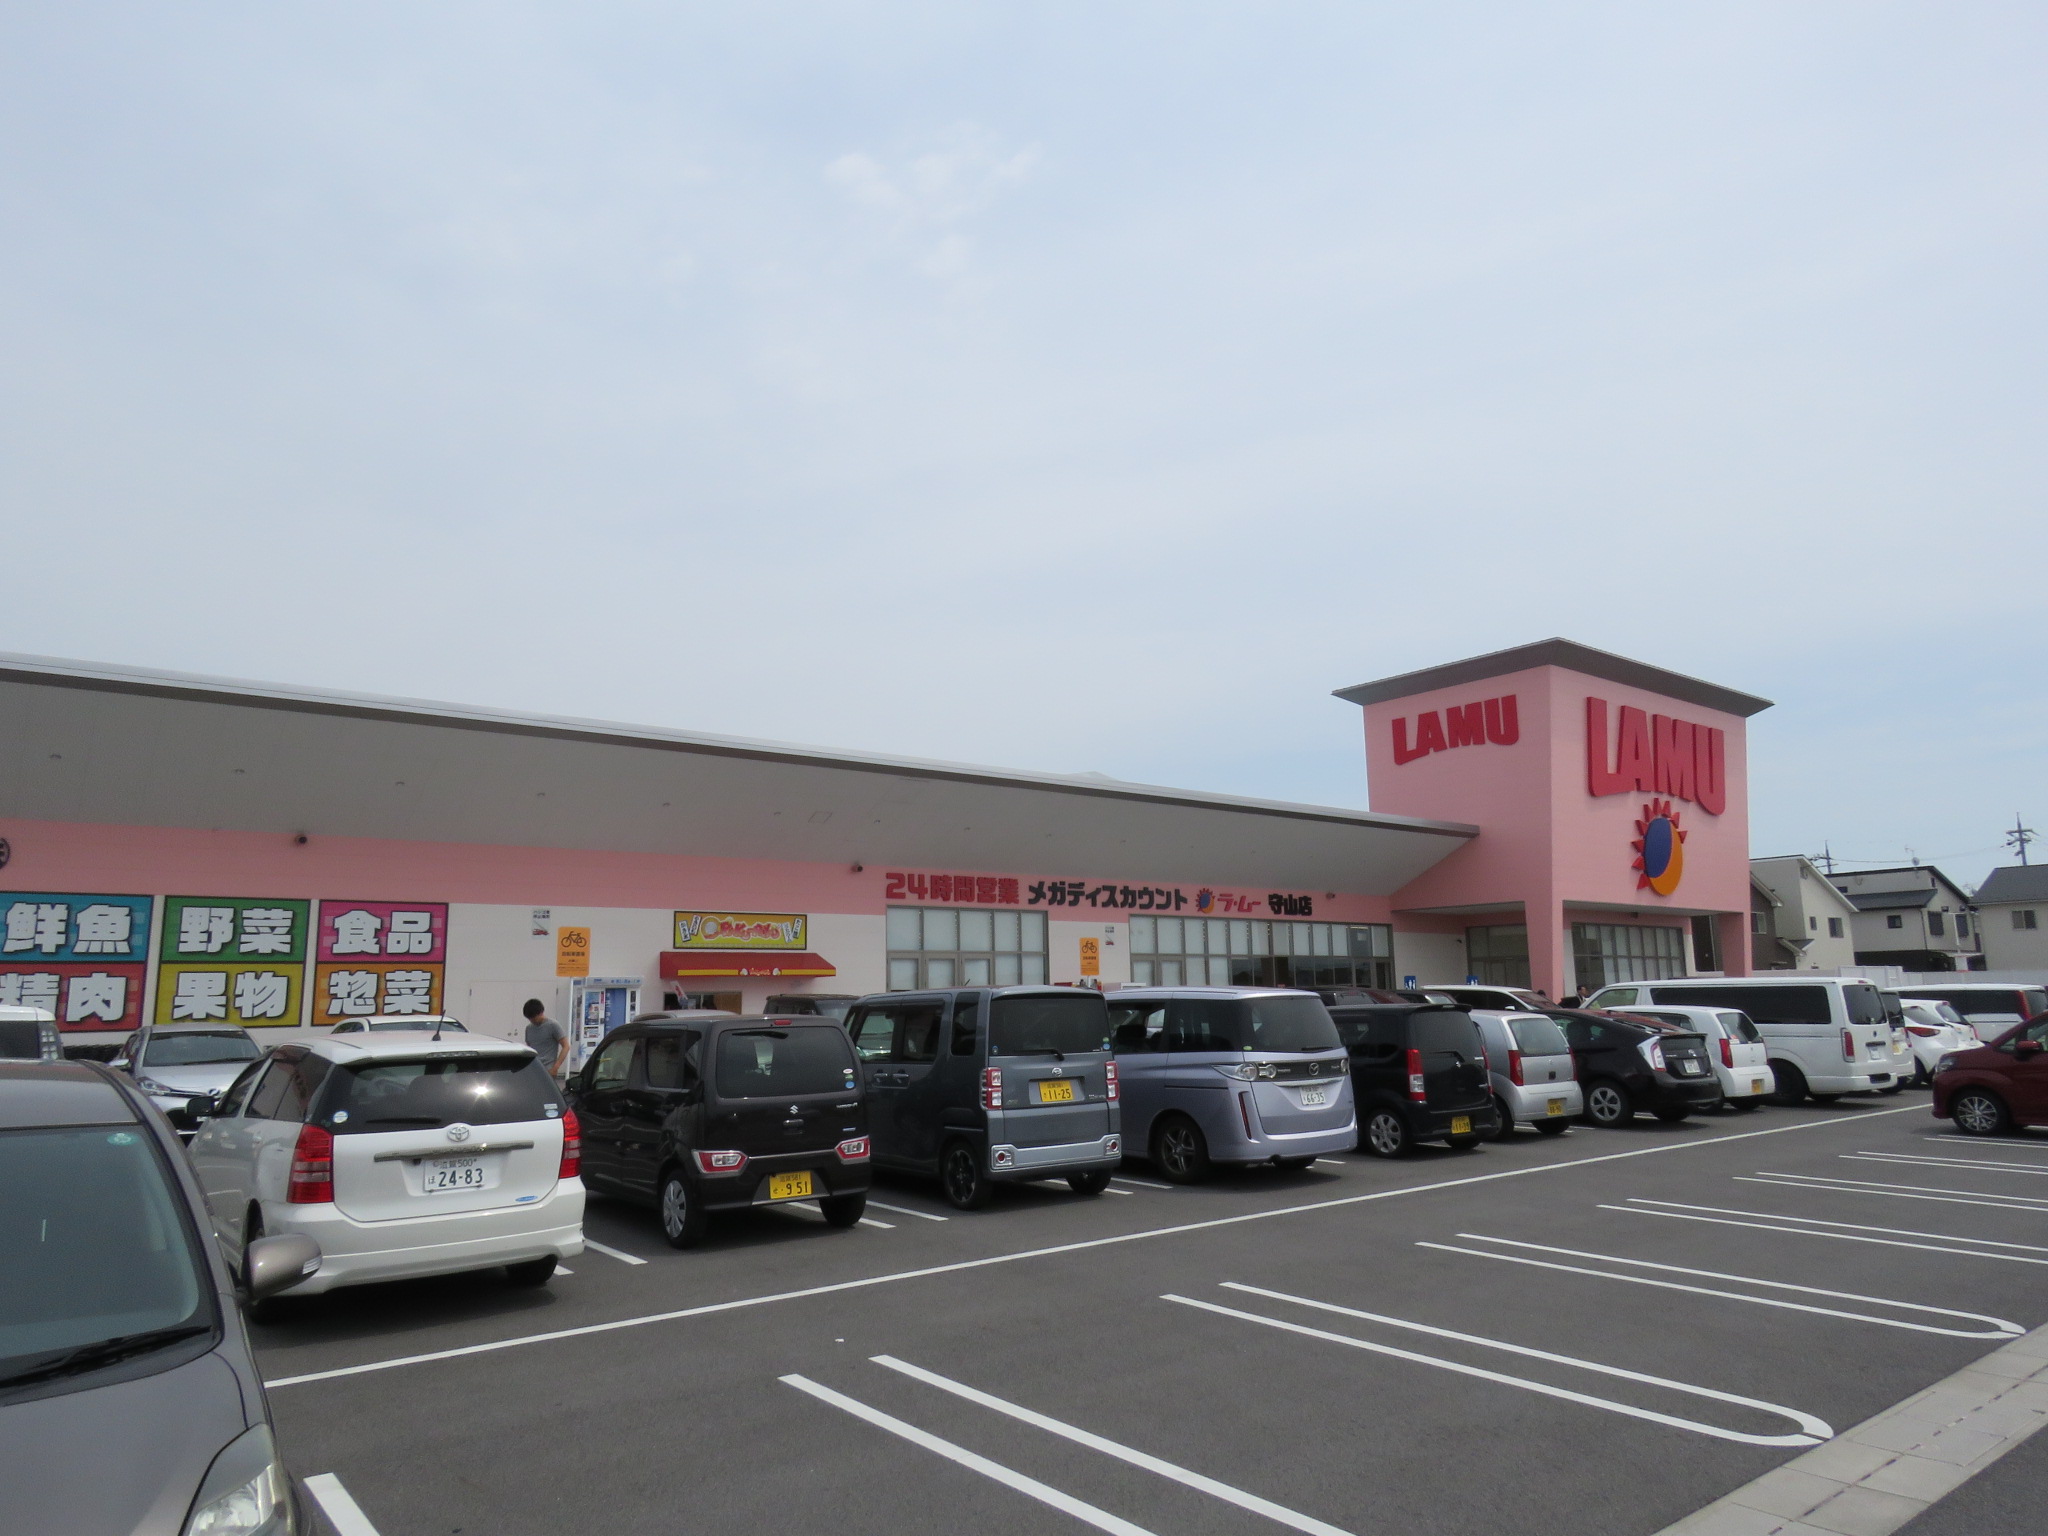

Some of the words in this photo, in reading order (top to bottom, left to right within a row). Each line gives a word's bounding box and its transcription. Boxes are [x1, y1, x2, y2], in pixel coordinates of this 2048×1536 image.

[1392, 694, 1519, 765] LAMU
[1587, 696, 1726, 815] LAMU
[886, 872, 1018, 906] 24時間営業
[1027, 879, 1188, 912] メガディスカウント
[1268, 893, 1313, 916] 守山店
[3, 901, 131, 954] 鮮魚
[177, 907, 294, 956] 野菜
[331, 910, 433, 956] 食品
[0, 971, 127, 1022] 精肉
[173, 970, 289, 1021] 果物
[327, 970, 433, 1016] 惣菜
[438, 1167, 484, 1188] 24-83
